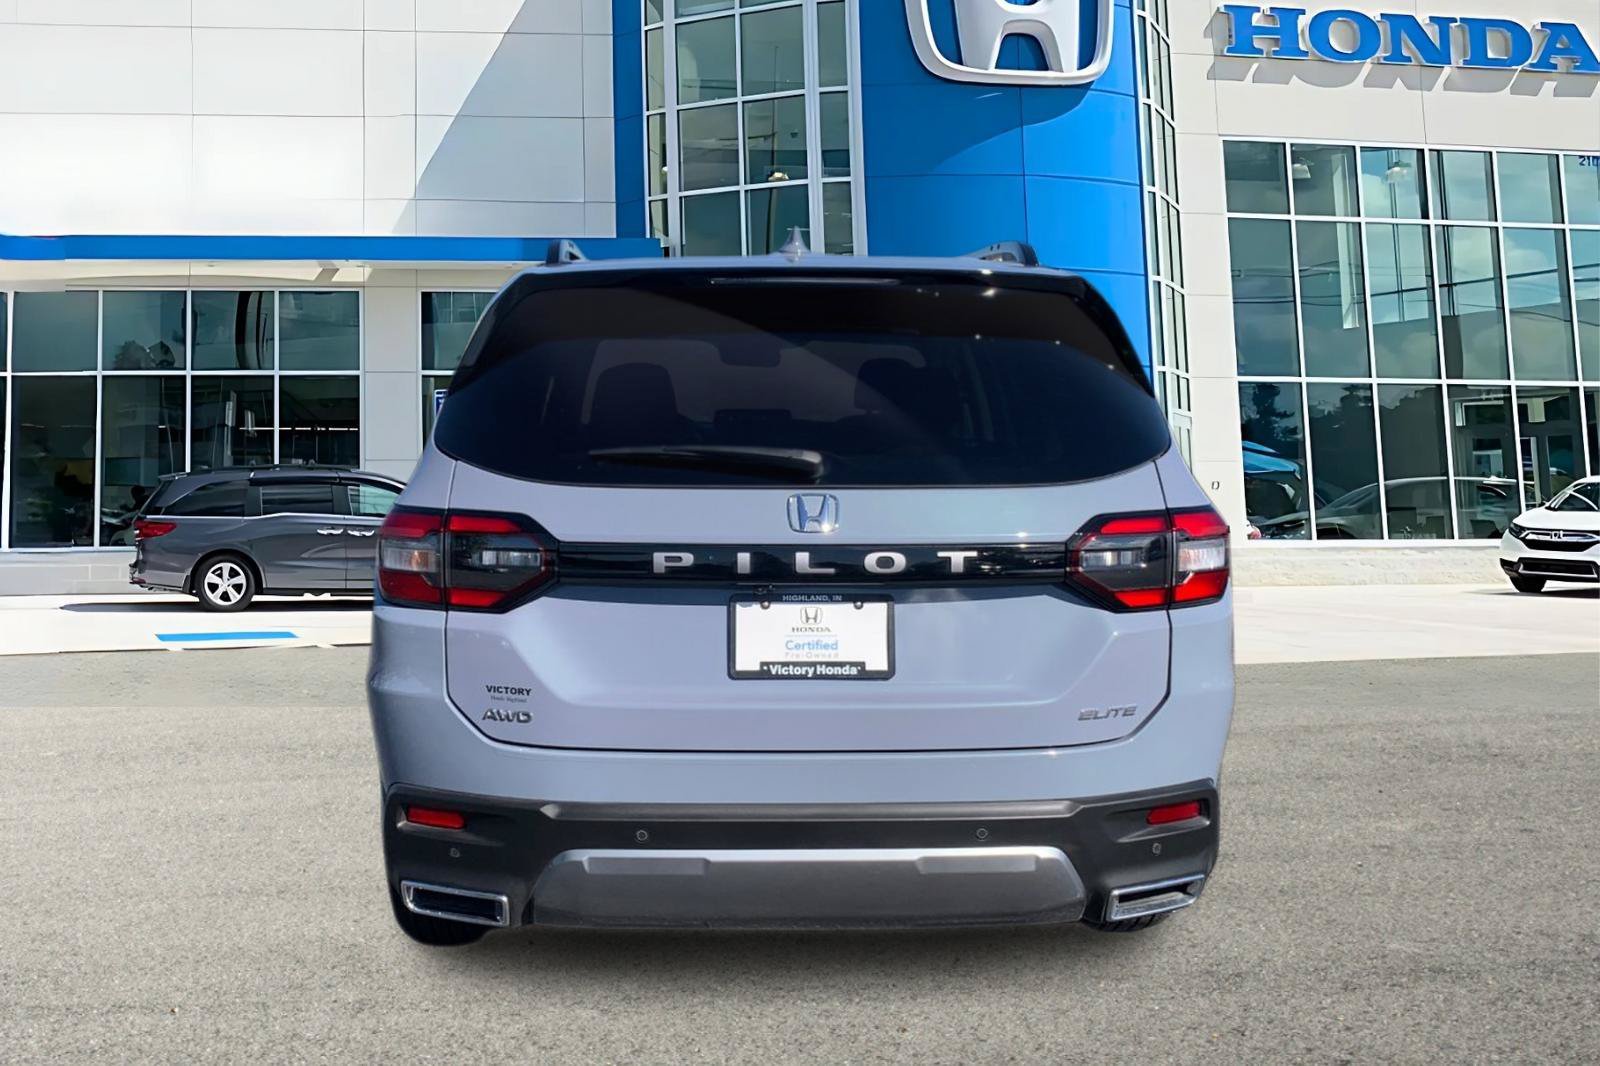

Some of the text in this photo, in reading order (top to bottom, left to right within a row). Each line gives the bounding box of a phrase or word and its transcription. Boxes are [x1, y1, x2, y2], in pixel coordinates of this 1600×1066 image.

[1222, 4, 1600, 73] HONDA
[652, 551, 979, 574] PILOT
[785, 639, 839, 651] Certified
[769, 664, 858, 677] Victory Honda
[485, 685, 532, 696] VICTORY
[482, 708, 532, 723] AWD
[1078, 705, 1138, 721] ELITE
